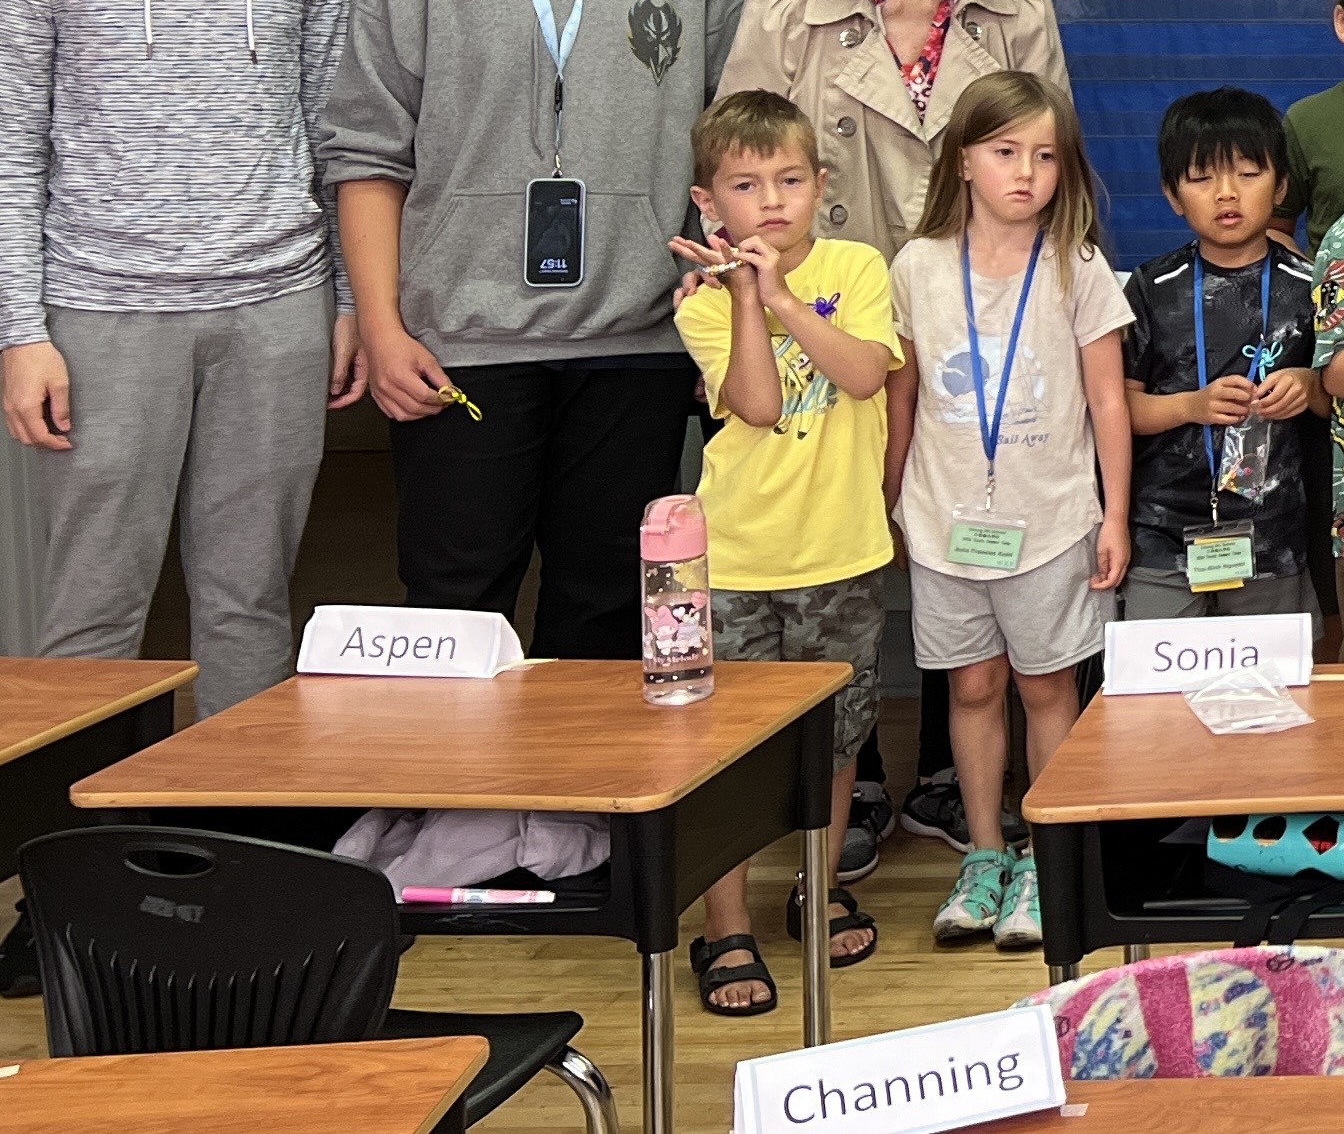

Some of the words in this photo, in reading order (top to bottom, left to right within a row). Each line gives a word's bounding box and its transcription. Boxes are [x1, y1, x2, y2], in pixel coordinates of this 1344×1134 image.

[540, 258, 568, 269] 11:57
[340, 627, 457, 666] Aspen
[1153, 639, 1260, 674] Sonia
[782, 1051, 1026, 1123] Channing
